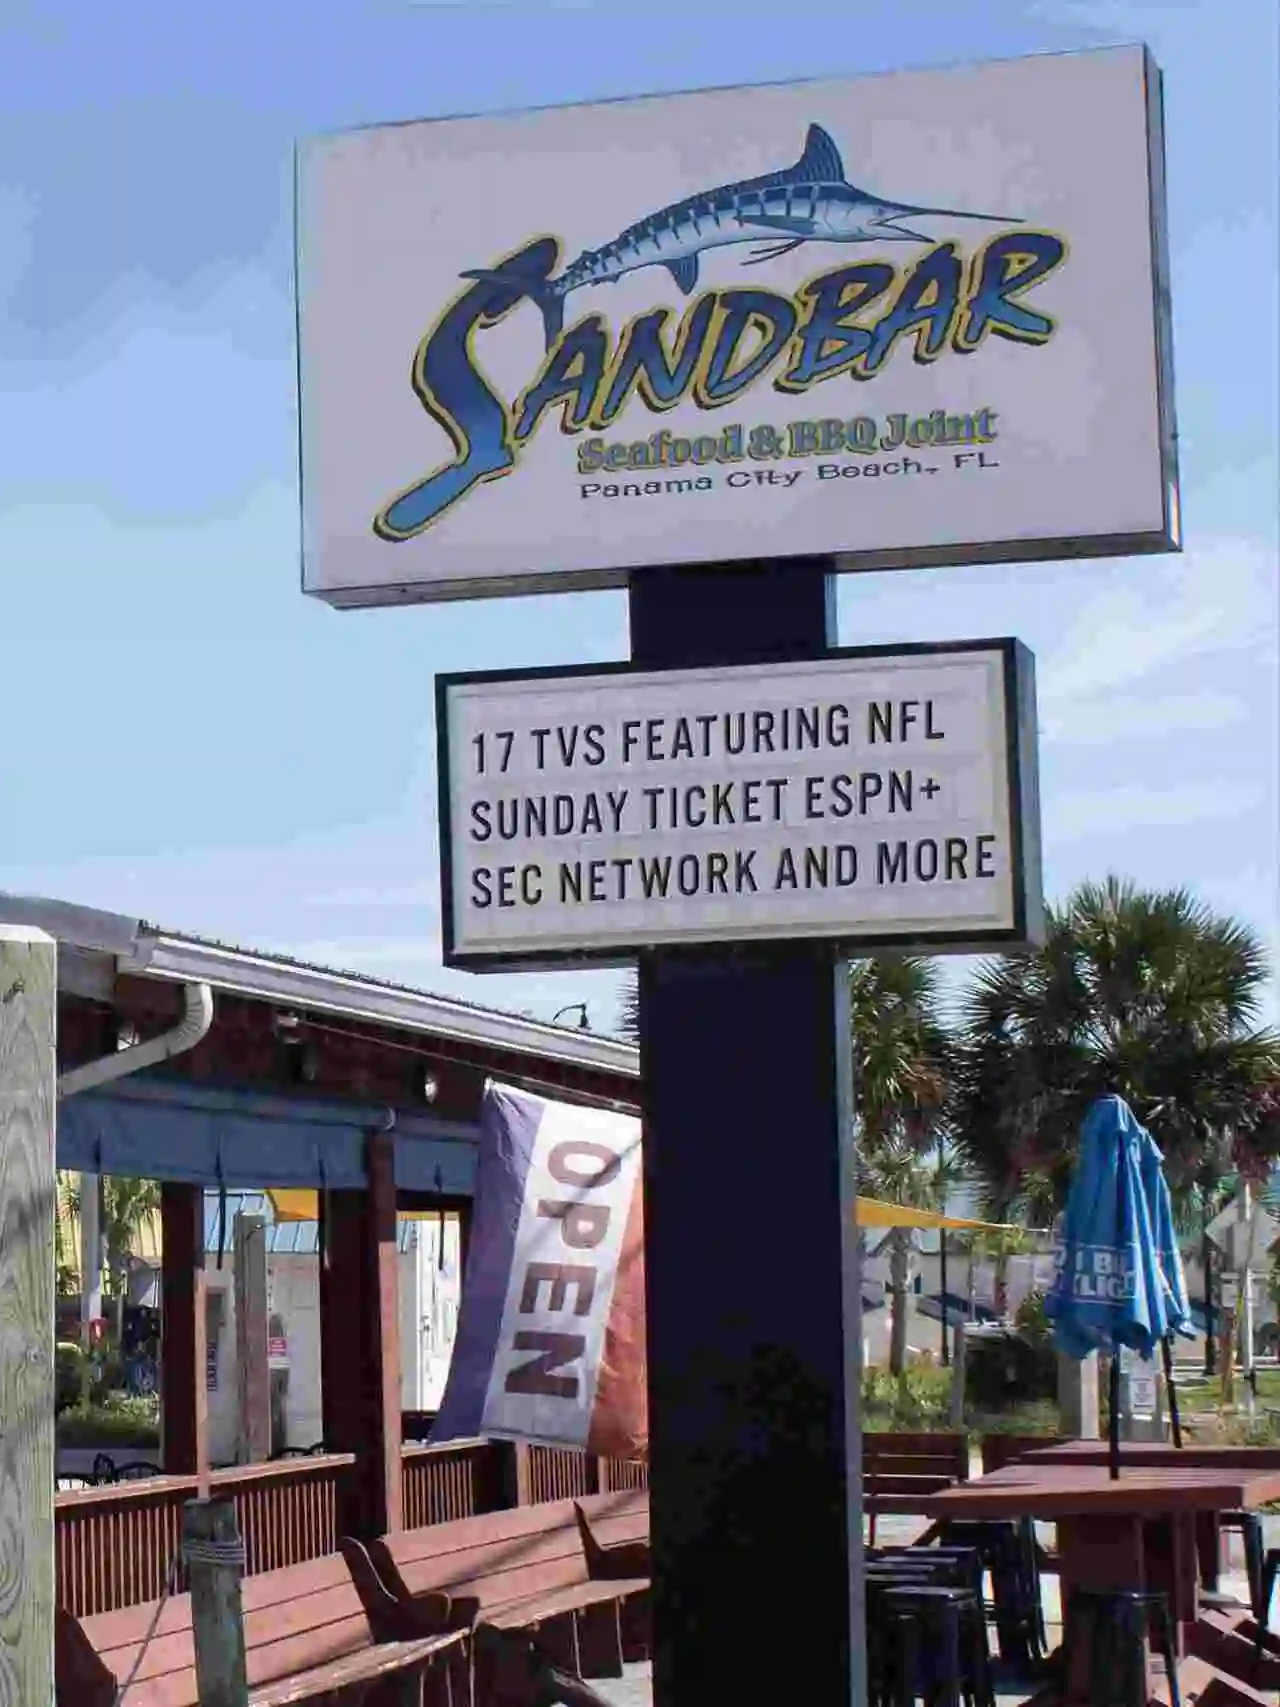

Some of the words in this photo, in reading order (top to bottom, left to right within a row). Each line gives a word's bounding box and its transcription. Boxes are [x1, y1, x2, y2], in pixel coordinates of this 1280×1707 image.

[373, 230, 1064, 542] SANDBAR
[577, 424, 743, 474] Seafood
[747, 424, 786, 461] &
[788, 417, 880, 457] BBQ
[880, 406, 999, 450] Joint
[581, 475, 713, 500] Panama
[727, 468, 802, 488] City
[955, 452, 1000, 470] FL
[472, 731, 515, 773] 17
[530, 724, 606, 770] TVS
[622, 704, 850, 763] FEATURING
[867, 700, 945, 744] NFL
[471, 790, 628, 842] SUNDAY
[643, 778, 788, 829] TICKET
[805, 769, 942, 818] ESPN+
[471, 863, 542, 908] SEC
[558, 849, 758, 904] NETWORK
[774, 844, 858, 890] AND
[876, 834, 997, 885] MORE
[505, 1141, 621, 1398] OPEN
